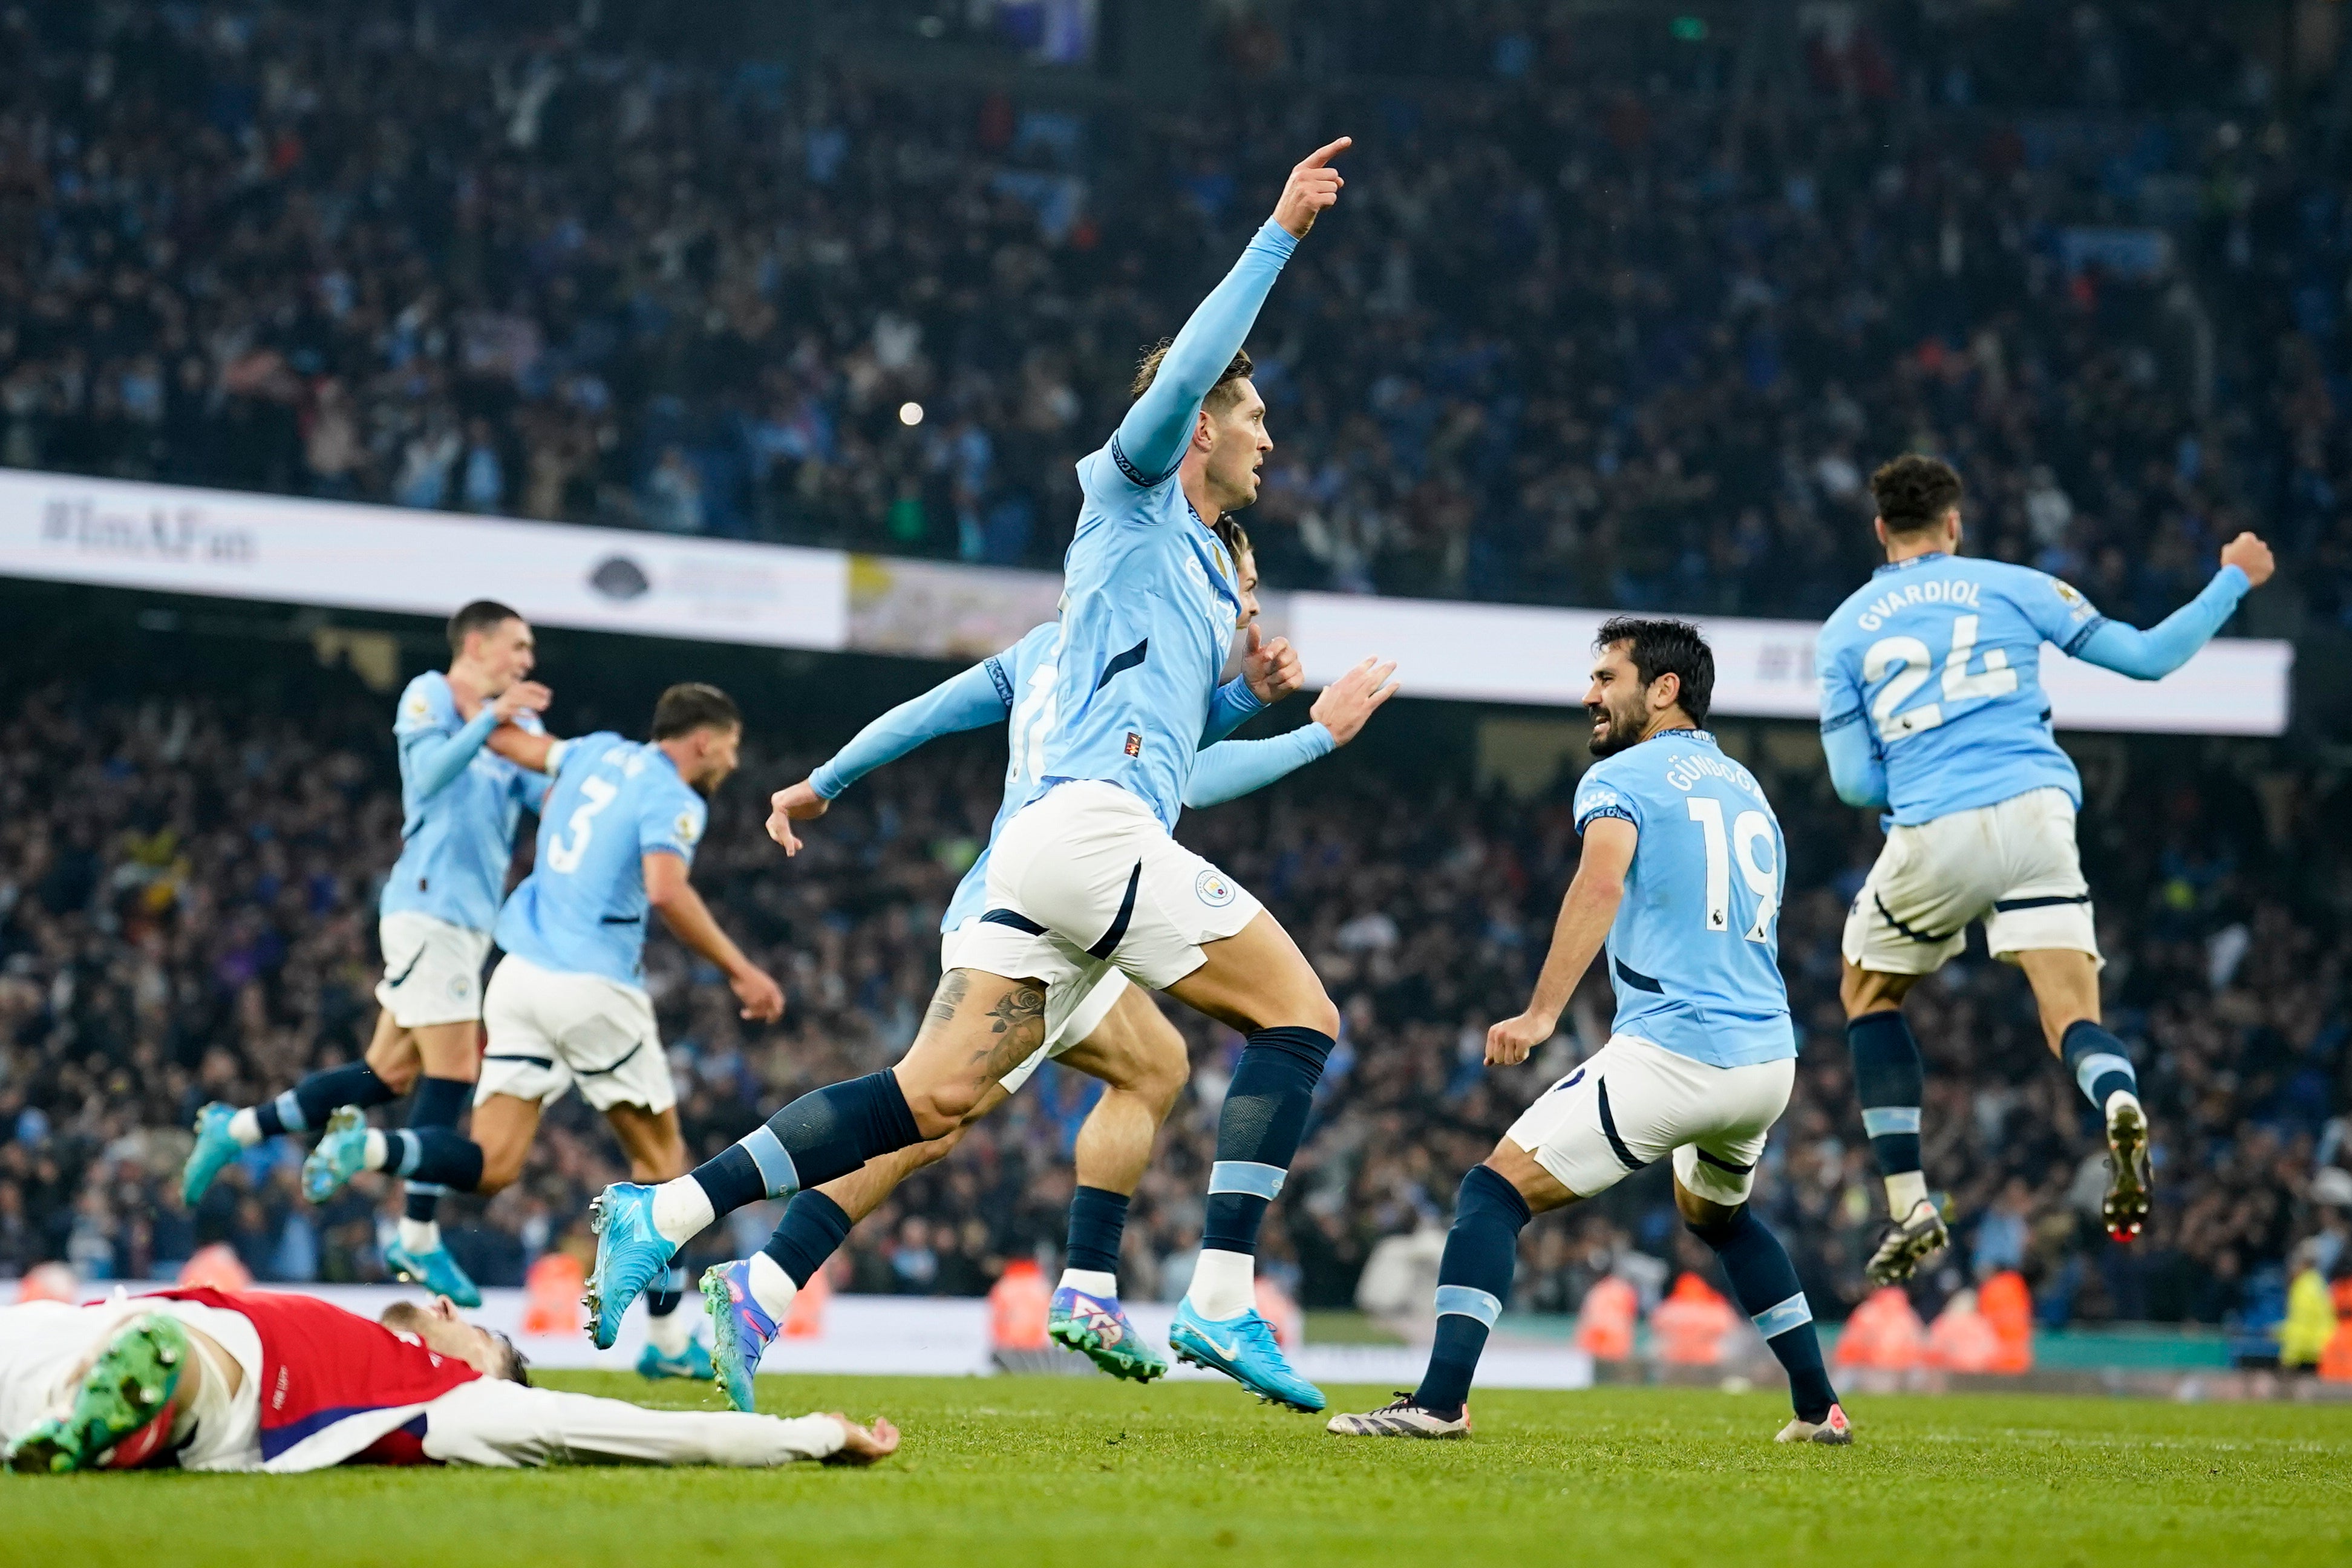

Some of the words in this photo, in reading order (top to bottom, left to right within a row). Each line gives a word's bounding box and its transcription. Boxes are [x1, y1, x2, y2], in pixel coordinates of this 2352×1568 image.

[1858, 579, 1981, 632] GVARDIOL
[1862, 613, 2018, 743] 24
[546, 774, 618, 875] 3
[1685, 796, 1778, 944] 19
